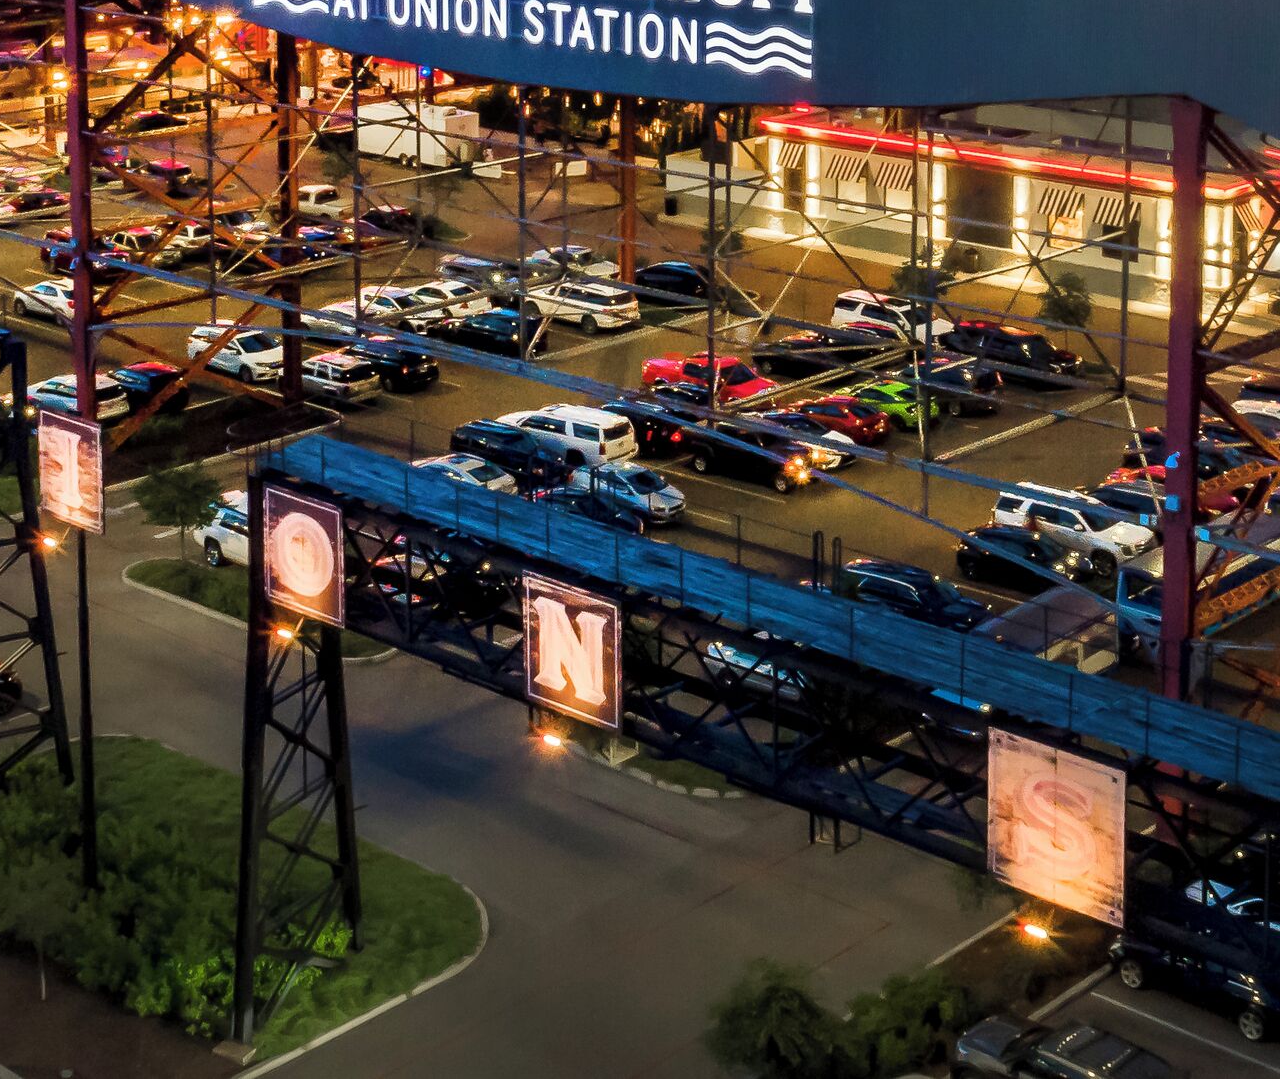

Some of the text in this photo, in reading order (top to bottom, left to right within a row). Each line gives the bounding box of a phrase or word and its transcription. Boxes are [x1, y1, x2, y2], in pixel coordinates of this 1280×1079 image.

[272, 511, 335, 598] O
[533, 595, 608, 707] N
[1011, 773, 1098, 882] S
